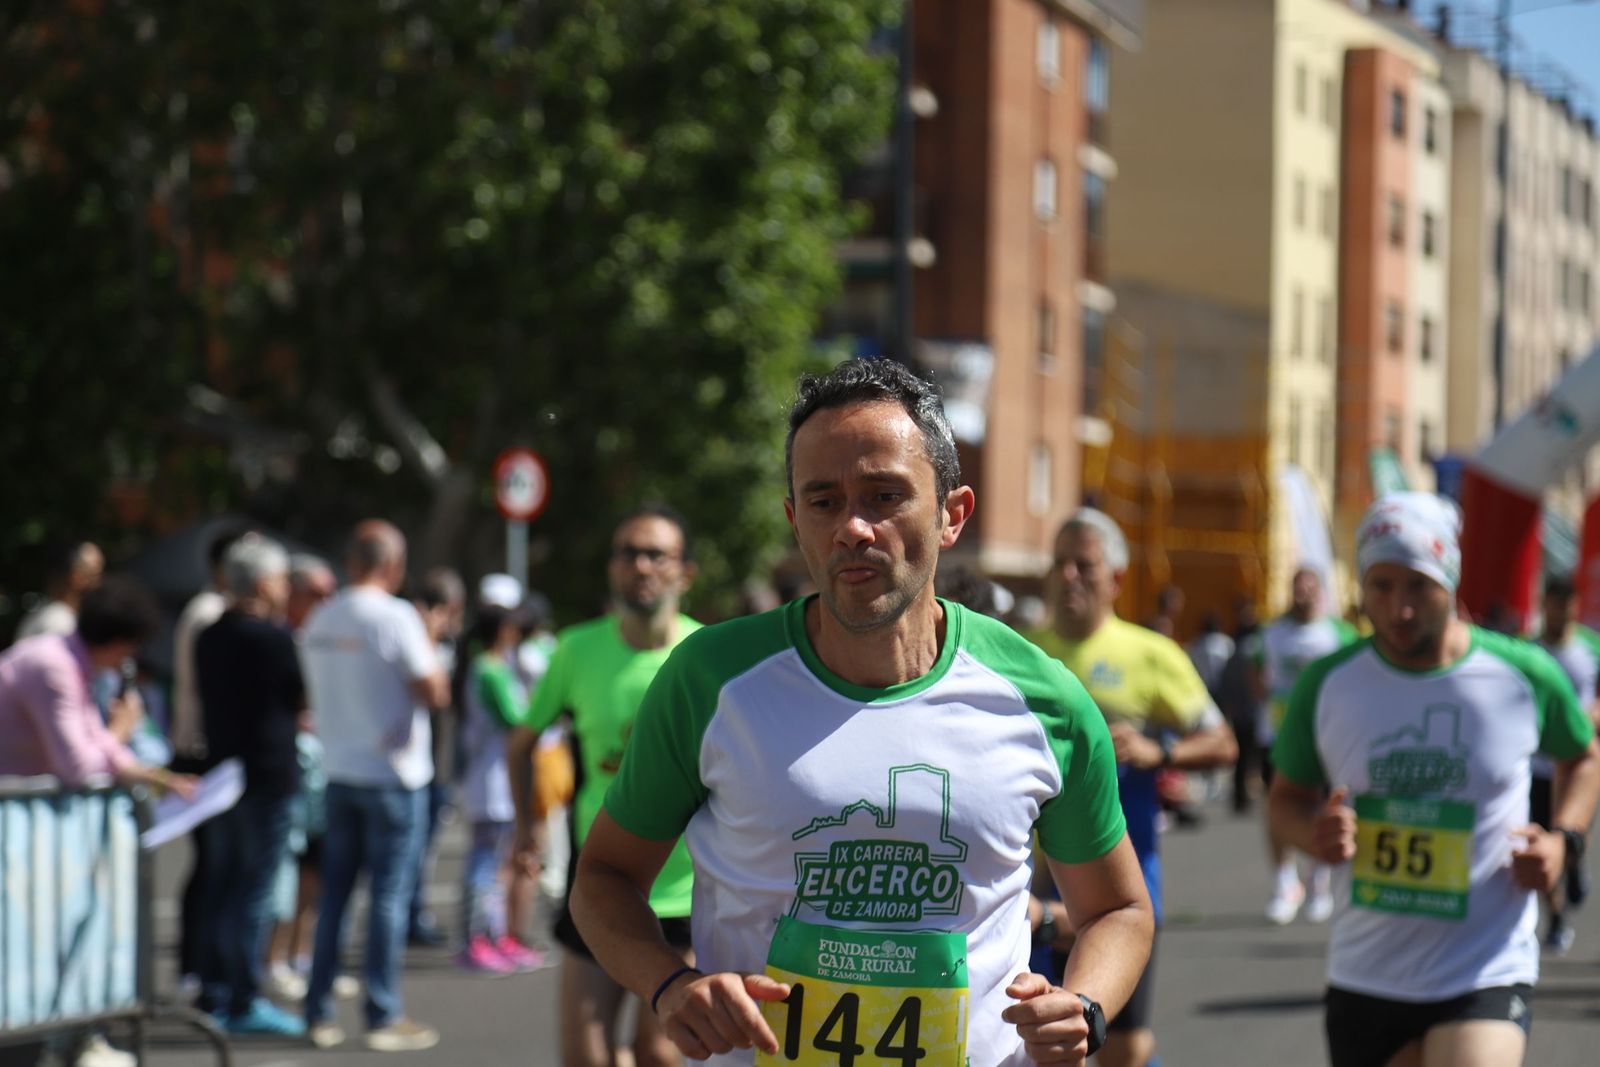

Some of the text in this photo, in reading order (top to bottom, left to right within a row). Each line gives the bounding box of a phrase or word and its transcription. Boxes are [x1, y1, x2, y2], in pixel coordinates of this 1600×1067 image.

[834, 845, 923, 863] IX CARRERA
[1375, 831, 1432, 879] 55
[803, 864, 953, 899] EL CERCO
[832, 901, 917, 918] DE ZAMORA
[818, 953, 916, 973] CAJA RURAL
[817, 968, 871, 981] DE ZAMORA
[781, 983, 926, 1067] 144
